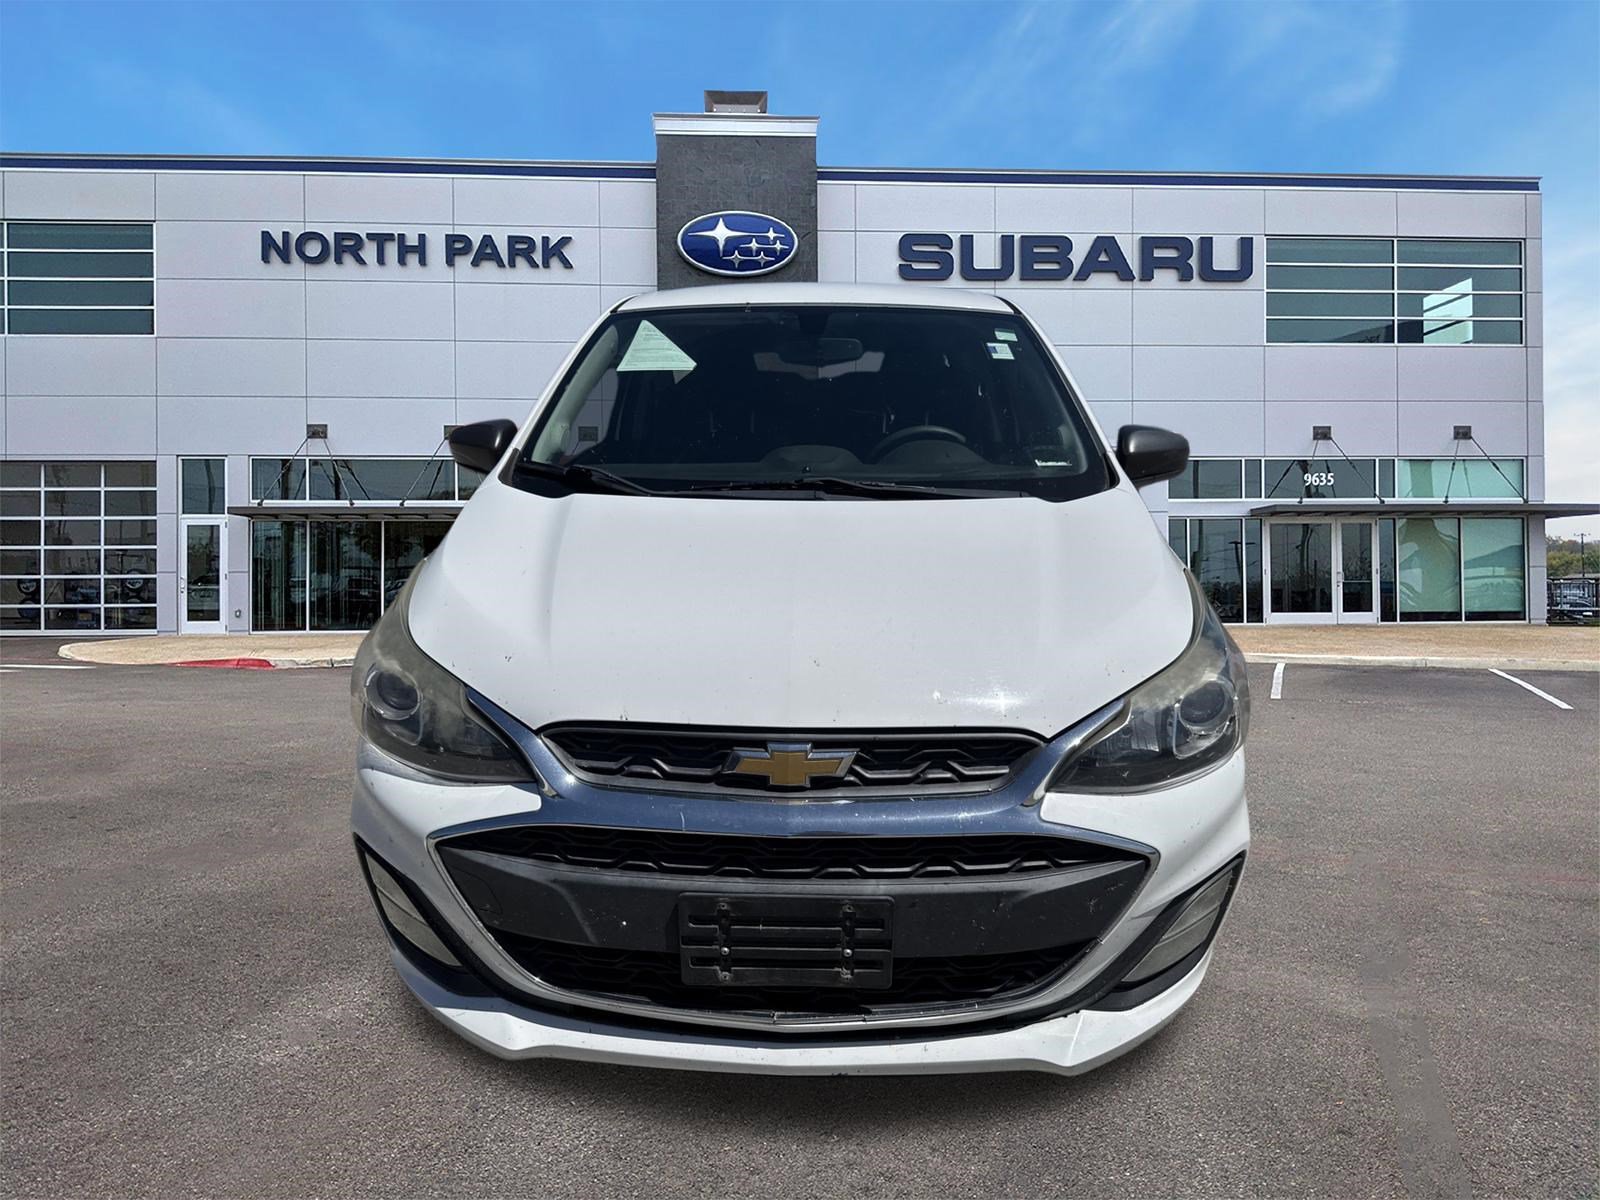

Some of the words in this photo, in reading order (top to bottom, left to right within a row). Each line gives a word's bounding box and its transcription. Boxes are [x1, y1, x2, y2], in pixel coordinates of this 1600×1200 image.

[260, 230, 427, 267] NORTH
[444, 233, 574, 269] PARK
[898, 233, 1254, 282] SUBARU
[1303, 472, 1335, 486] 9635
